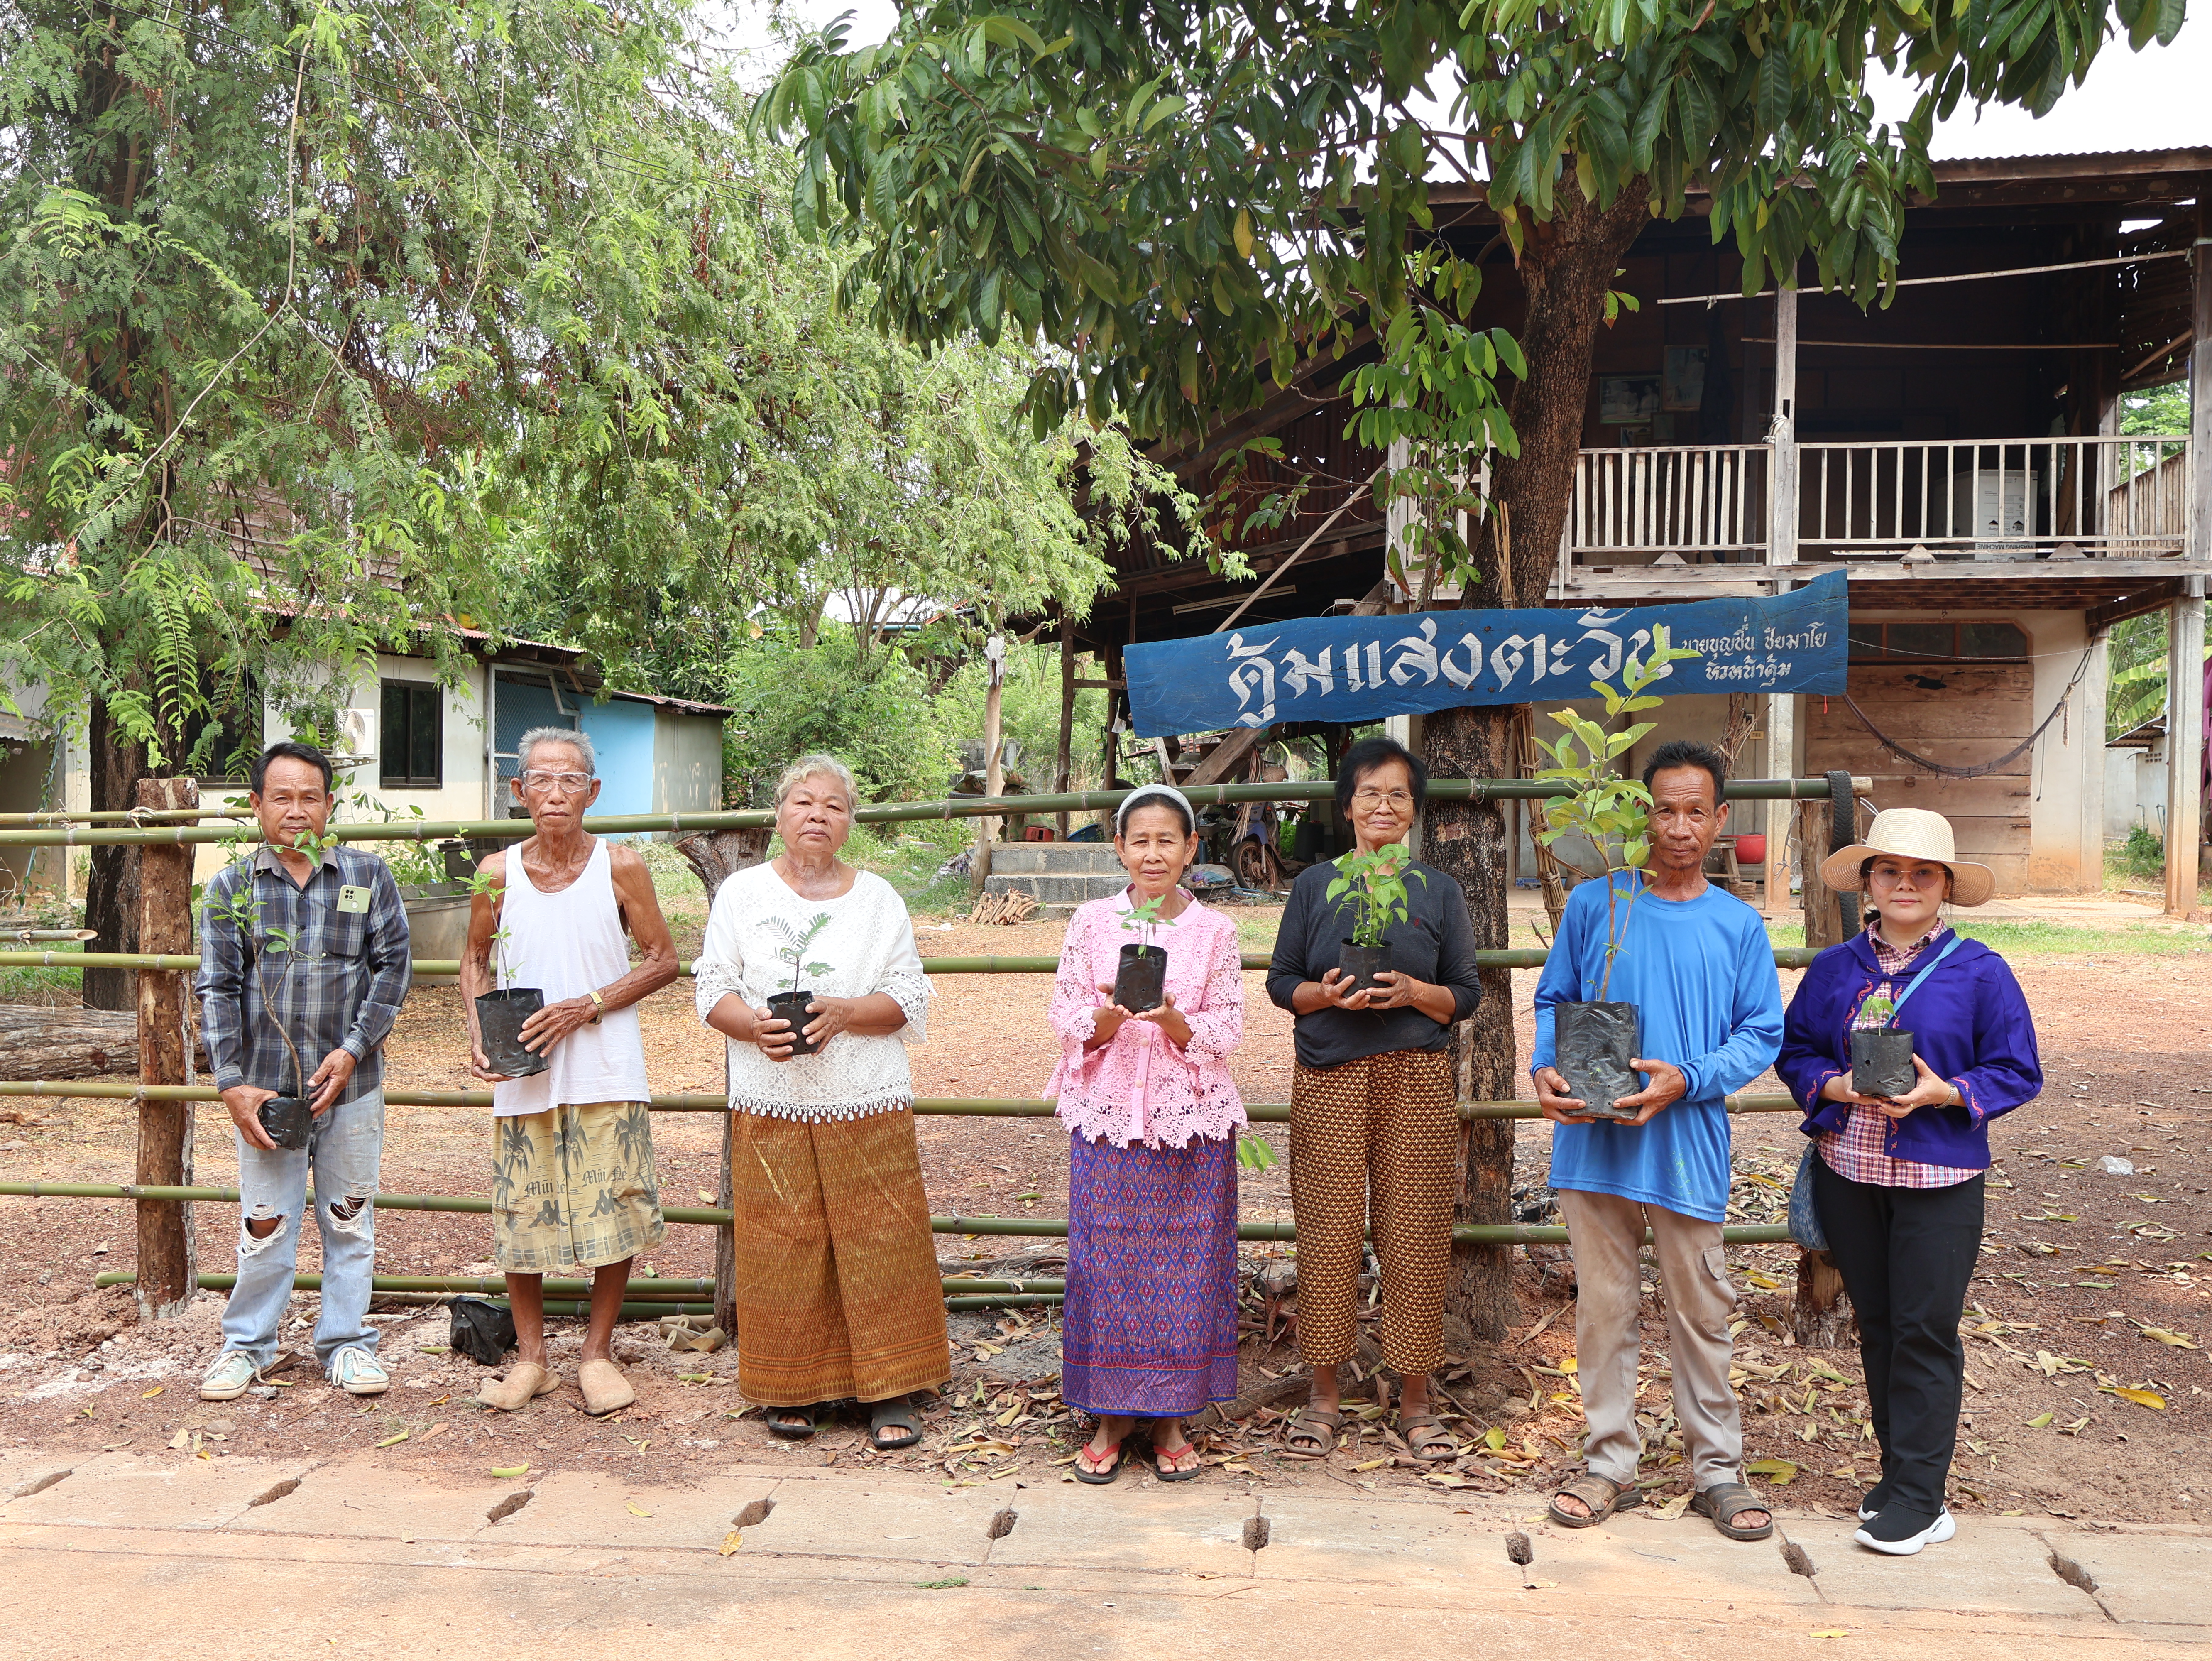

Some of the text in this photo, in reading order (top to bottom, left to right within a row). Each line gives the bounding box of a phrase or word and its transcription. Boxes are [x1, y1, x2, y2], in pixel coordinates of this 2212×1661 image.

[1225, 608, 1674, 728] คุ้มแสงตะวัน
